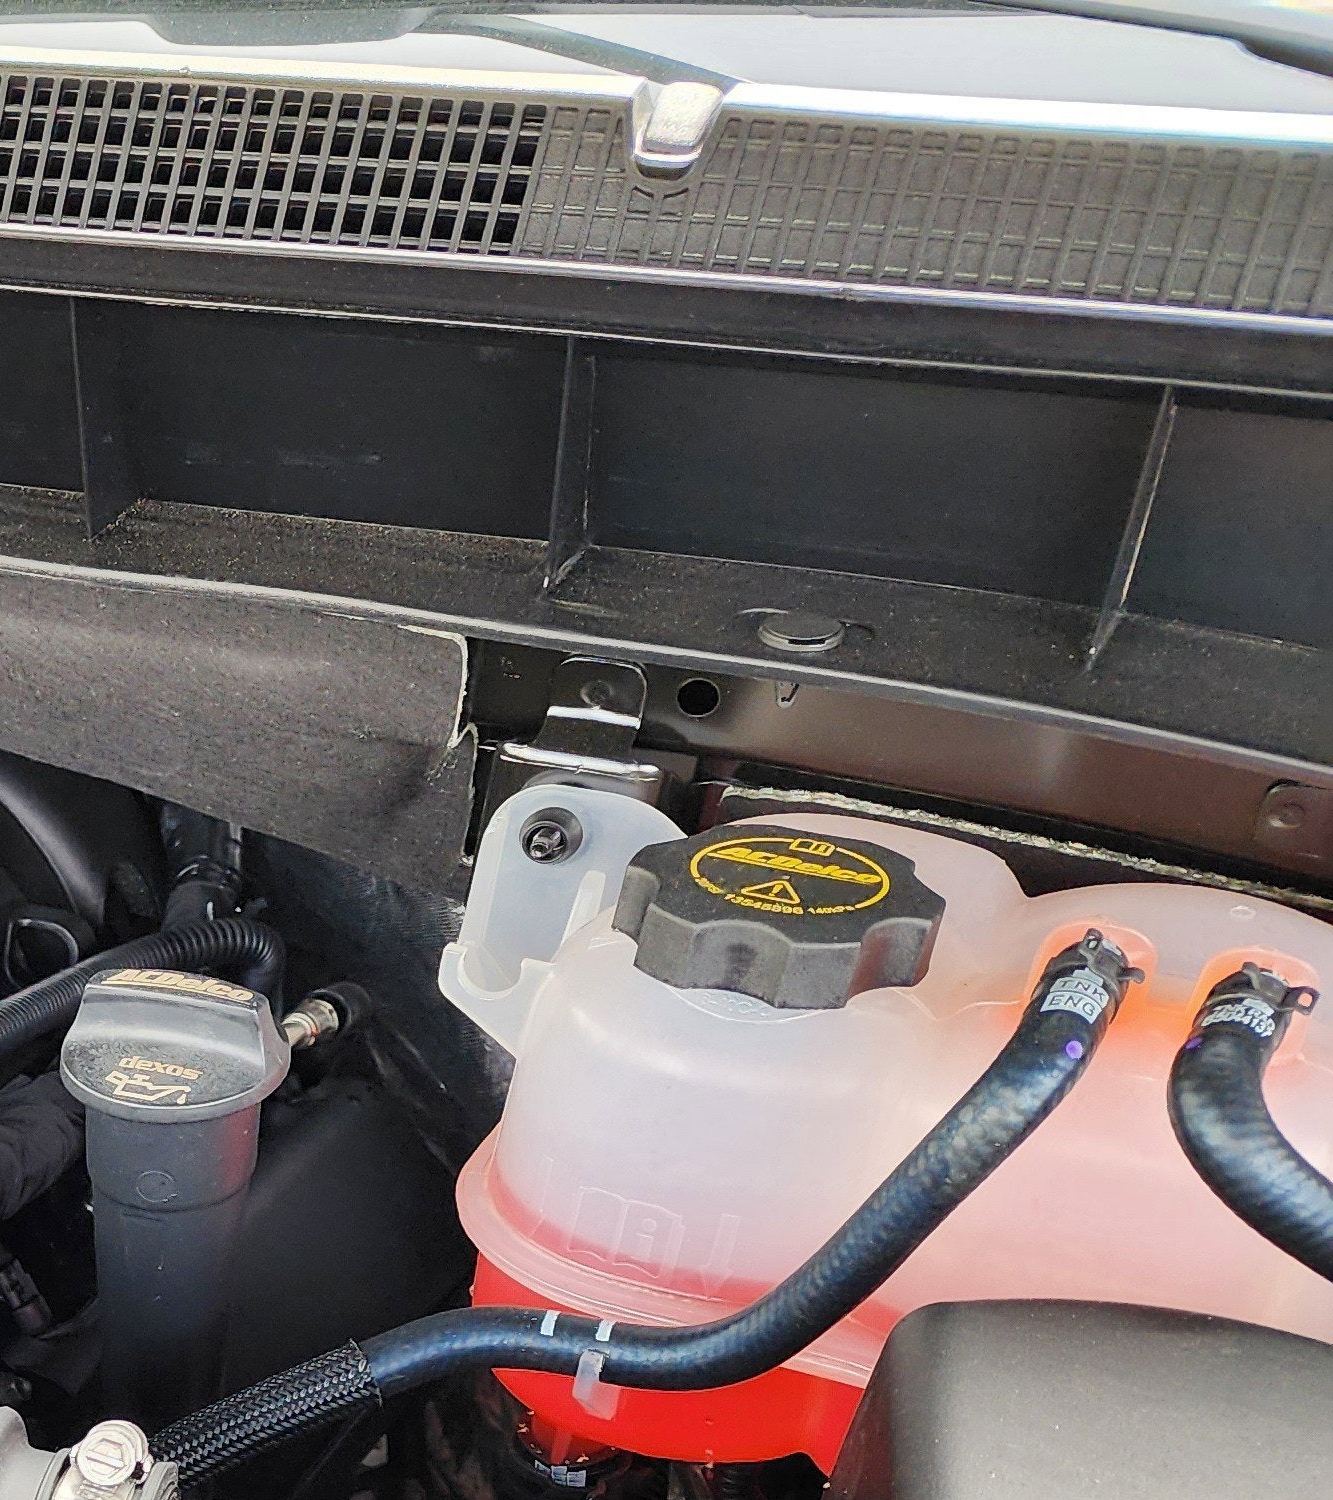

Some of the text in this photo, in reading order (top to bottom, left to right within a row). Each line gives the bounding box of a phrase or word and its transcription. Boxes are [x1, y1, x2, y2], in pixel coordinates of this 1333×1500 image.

[715, 846, 883, 884] ACDelco
[105, 968, 255, 1001] ACDelco
[1059, 978, 1104, 1000] TNK
[1048, 994, 1096, 1018] ENG
[118, 1056, 204, 1080] dexos
